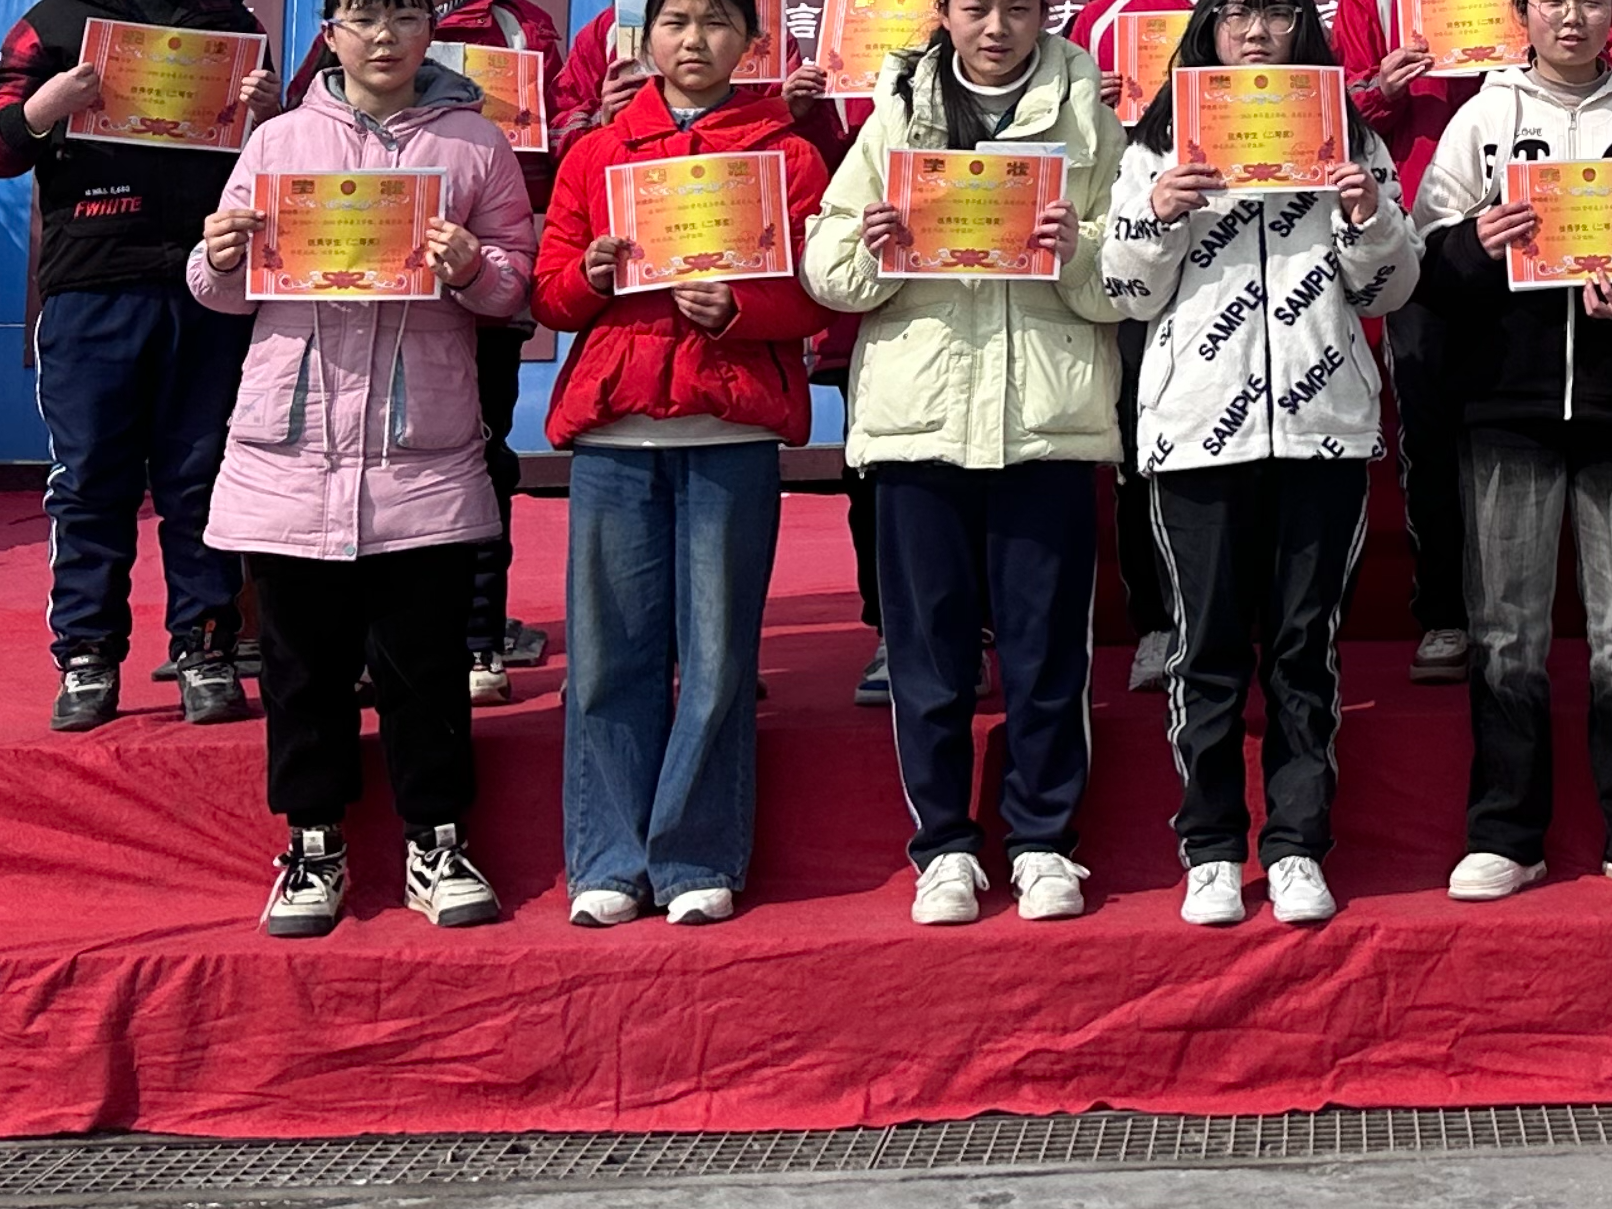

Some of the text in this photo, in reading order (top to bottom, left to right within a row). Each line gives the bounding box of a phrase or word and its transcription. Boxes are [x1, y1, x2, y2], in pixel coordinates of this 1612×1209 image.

[1190, 198, 1263, 269] SAMPLE
[1199, 278, 1268, 362] SAMPLE
[1273, 249, 1340, 327] SAMPLE
[1202, 372, 1269, 457] SAMPLE
[1277, 344, 1346, 416] SAMPLE
